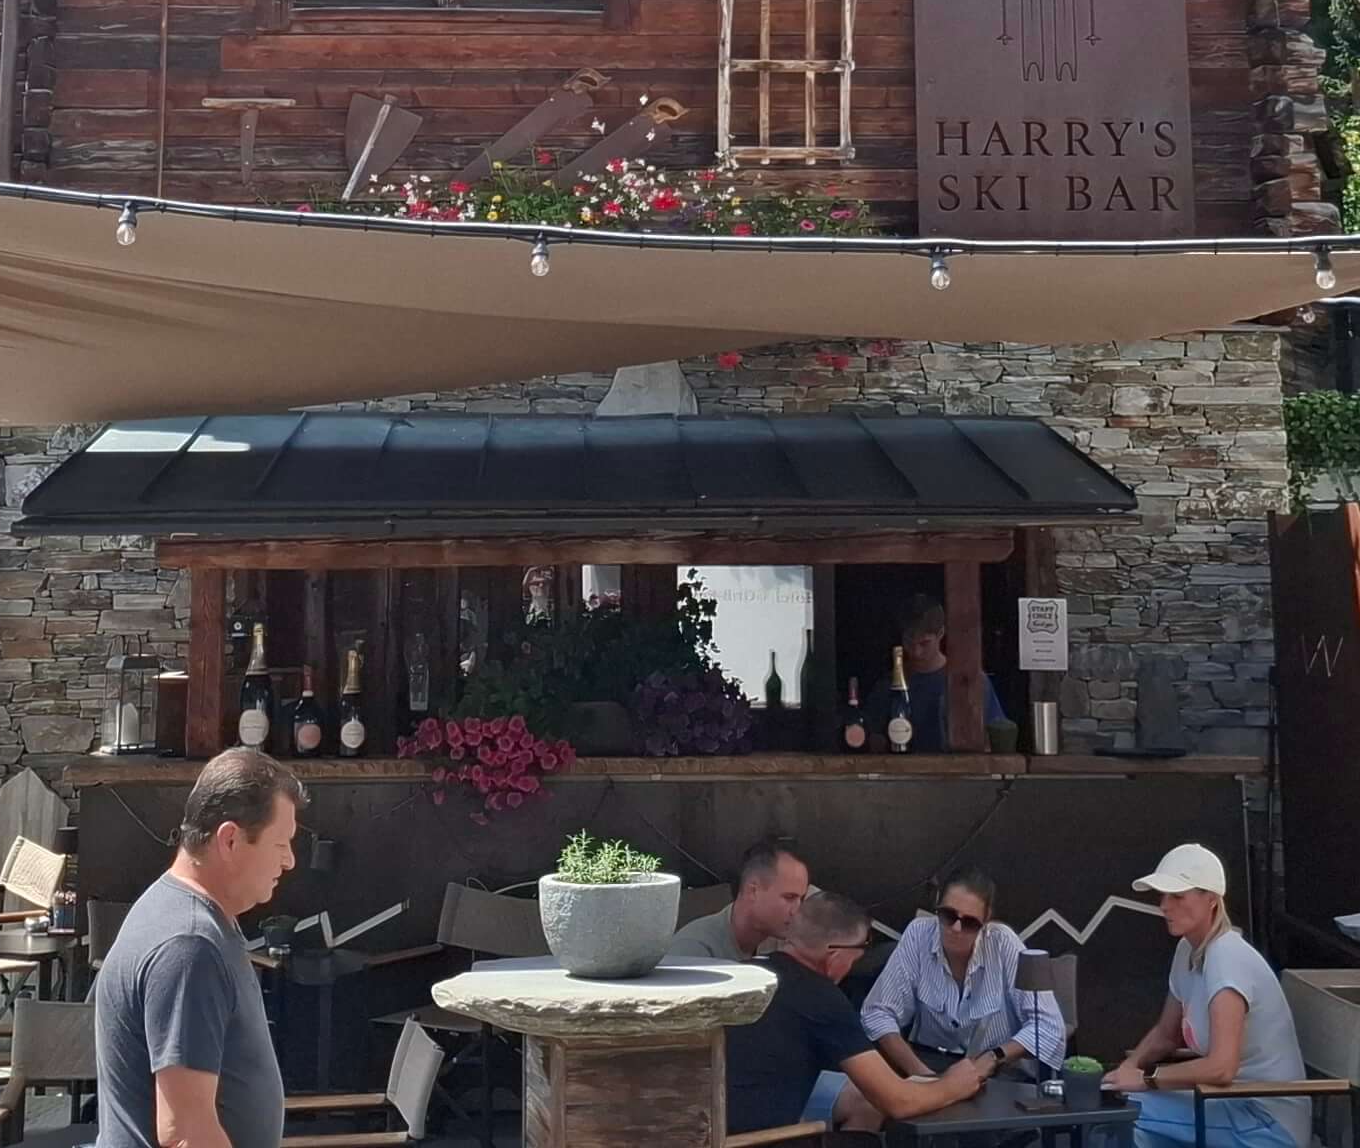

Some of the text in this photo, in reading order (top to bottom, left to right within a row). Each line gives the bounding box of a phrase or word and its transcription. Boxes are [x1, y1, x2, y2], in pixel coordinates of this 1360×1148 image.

[935, 120, 1177, 157] HARRY'S
[937, 175, 1181, 212] SKI BAR
